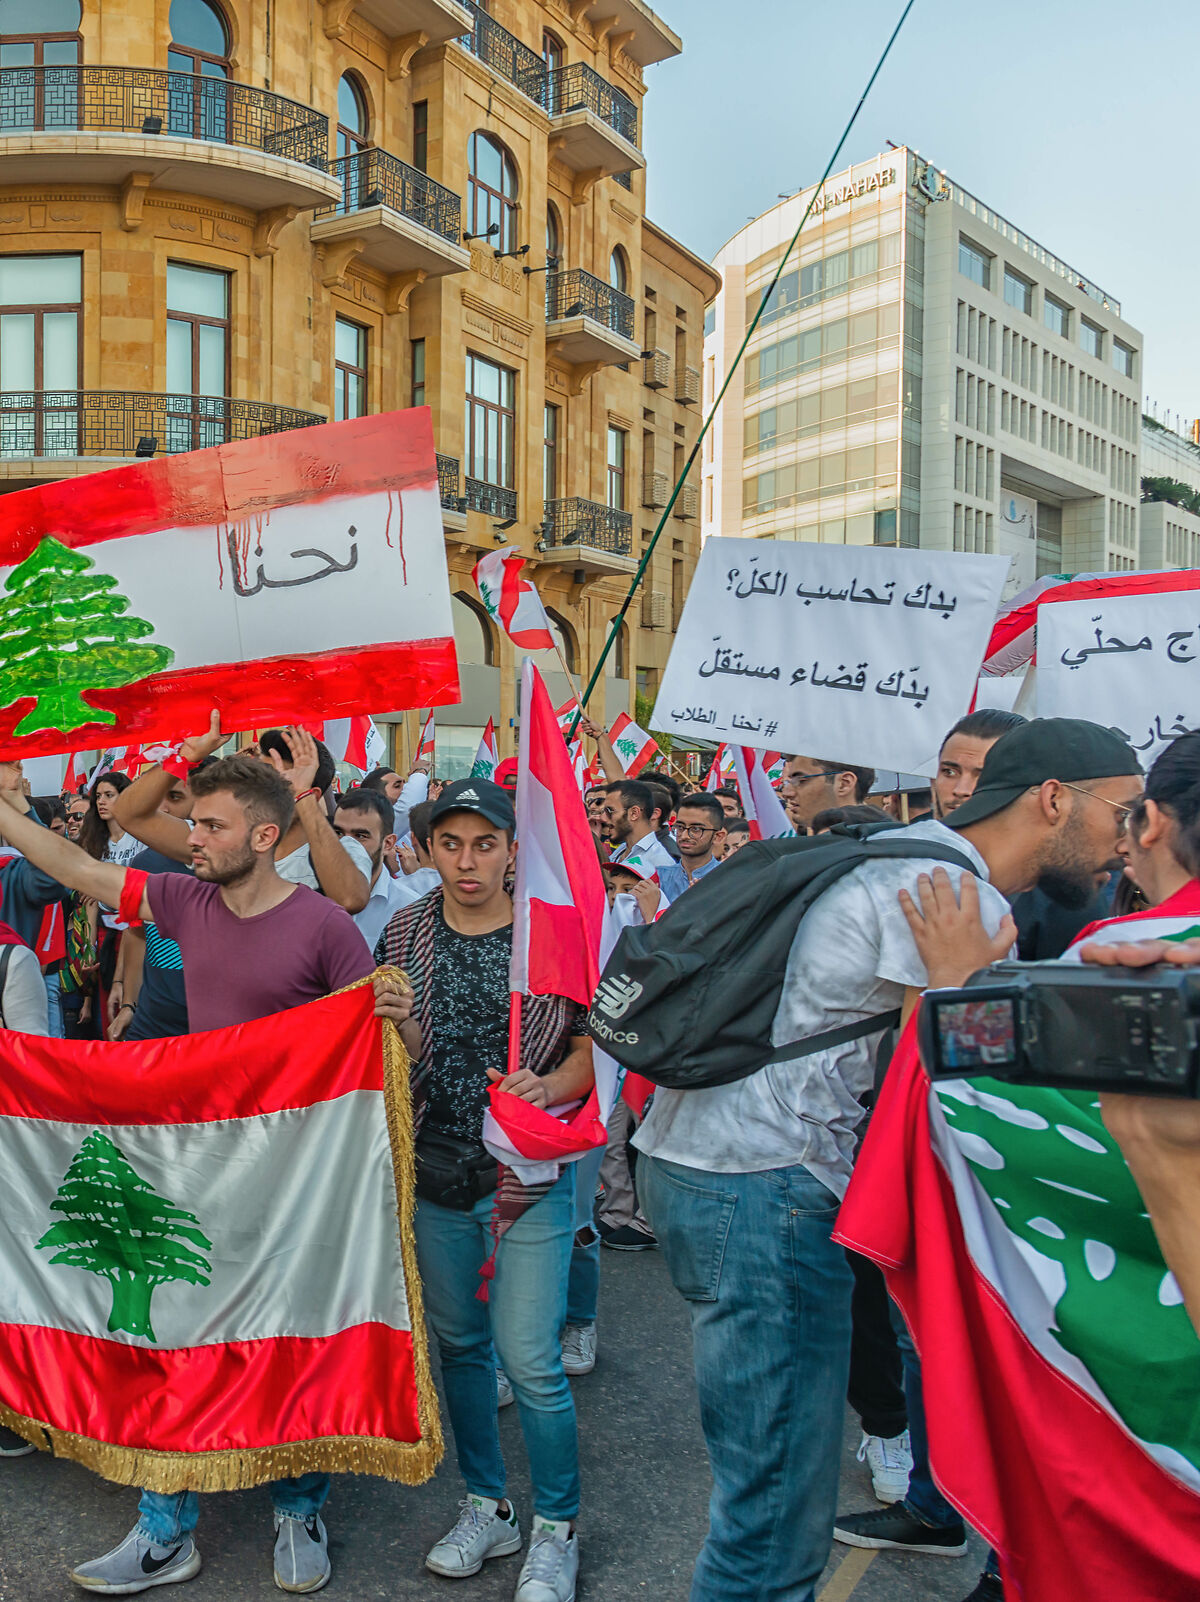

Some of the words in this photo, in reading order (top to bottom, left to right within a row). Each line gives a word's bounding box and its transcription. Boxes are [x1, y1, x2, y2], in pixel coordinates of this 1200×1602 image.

[227, 524, 359, 598] نحنا
[796, 577, 896, 607] تحاسب
[789, 661, 869, 693] قضاء
